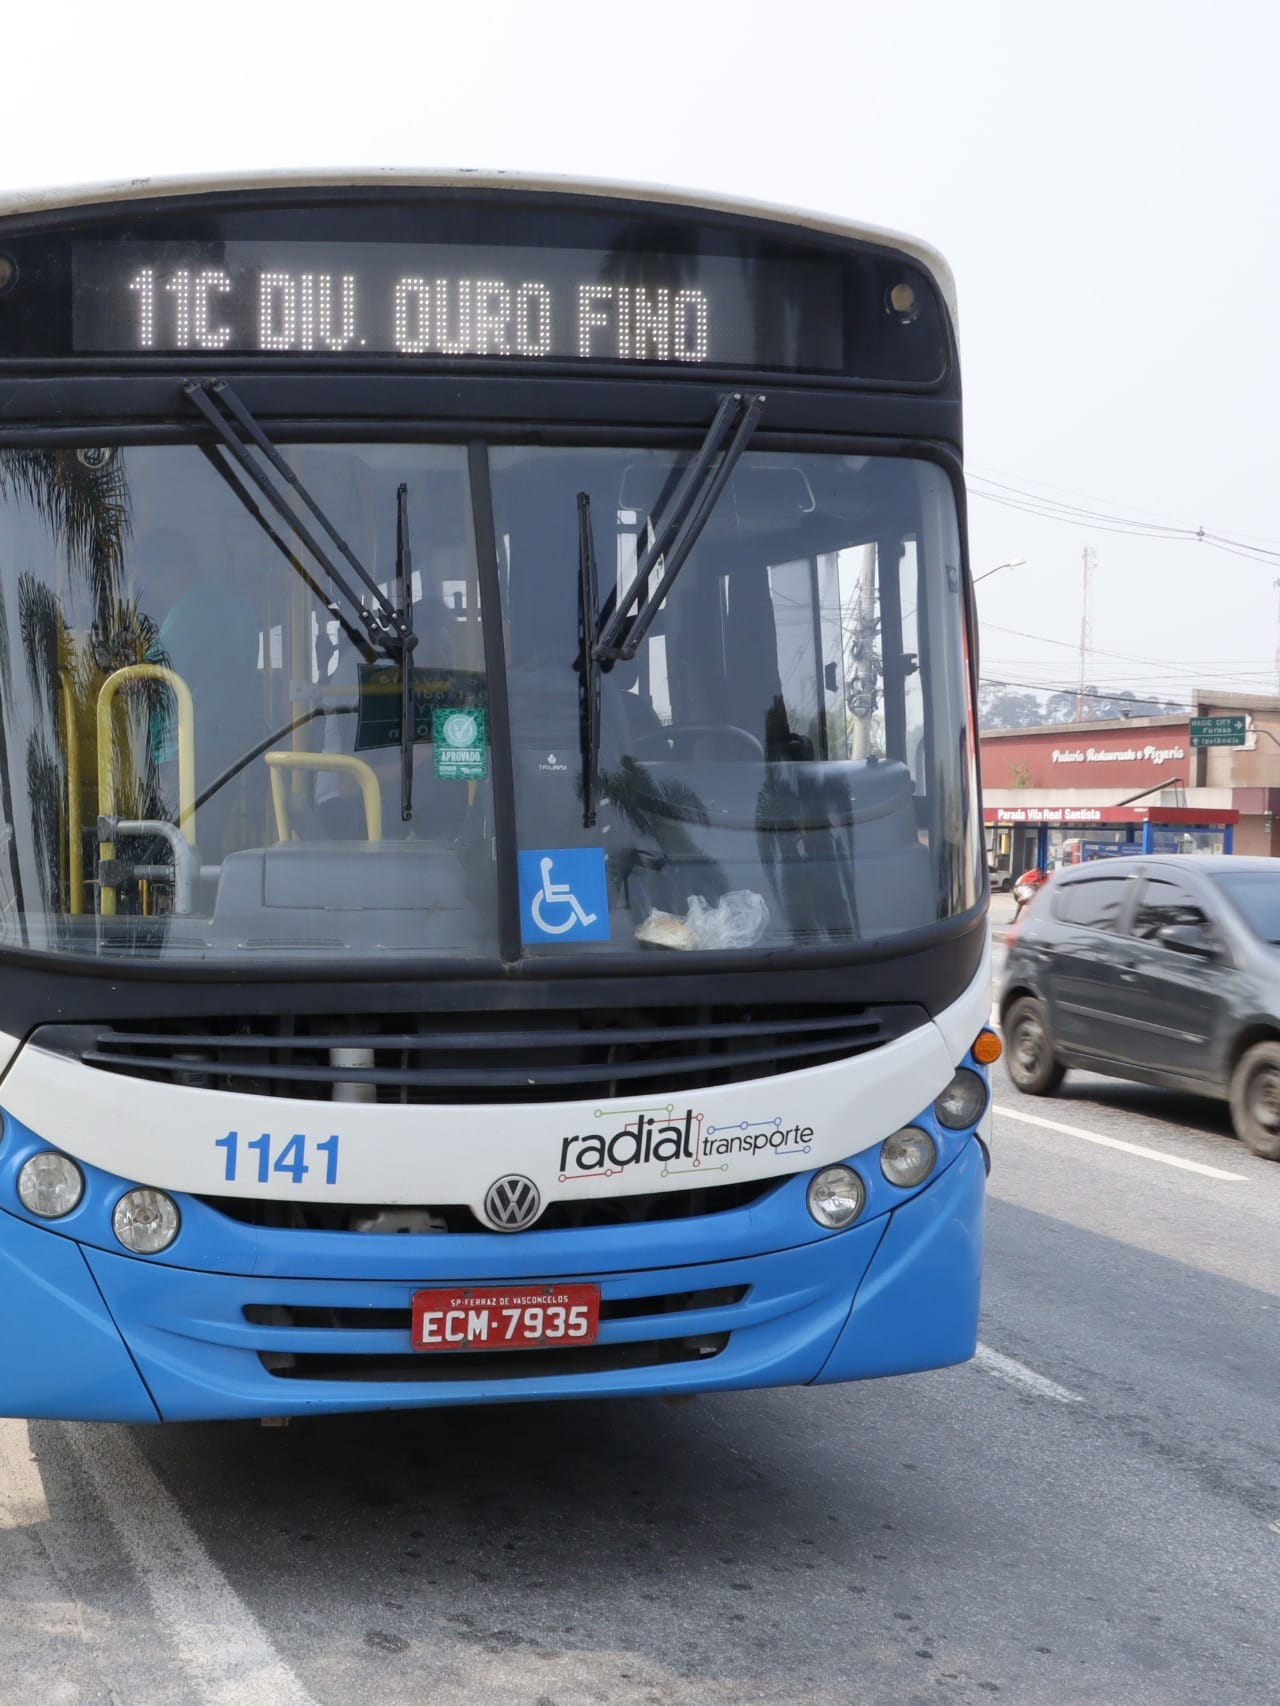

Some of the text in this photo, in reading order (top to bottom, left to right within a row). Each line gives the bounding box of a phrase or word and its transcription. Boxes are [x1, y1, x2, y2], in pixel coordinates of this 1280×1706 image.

[128, 268, 231, 349] 11C
[394, 277, 551, 357] OURO
[578, 284, 709, 362] FINO
[1215, 718, 1232, 727] CITY
[441, 751, 480, 762] APROVADO
[1052, 749, 1084, 763] Padaria
[1086, 747, 1136, 762] Restaurante
[1144, 745, 1185, 765] Pizzaria
[998, 808, 1101, 820] Parada Vila Real Santista
[559, 1109, 814, 1173] radial transporte
[215, 1131, 339, 1185] 1141
[499, 1296, 510, 1306] DE
[512, 1295, 569, 1305] VASCONCELOS
